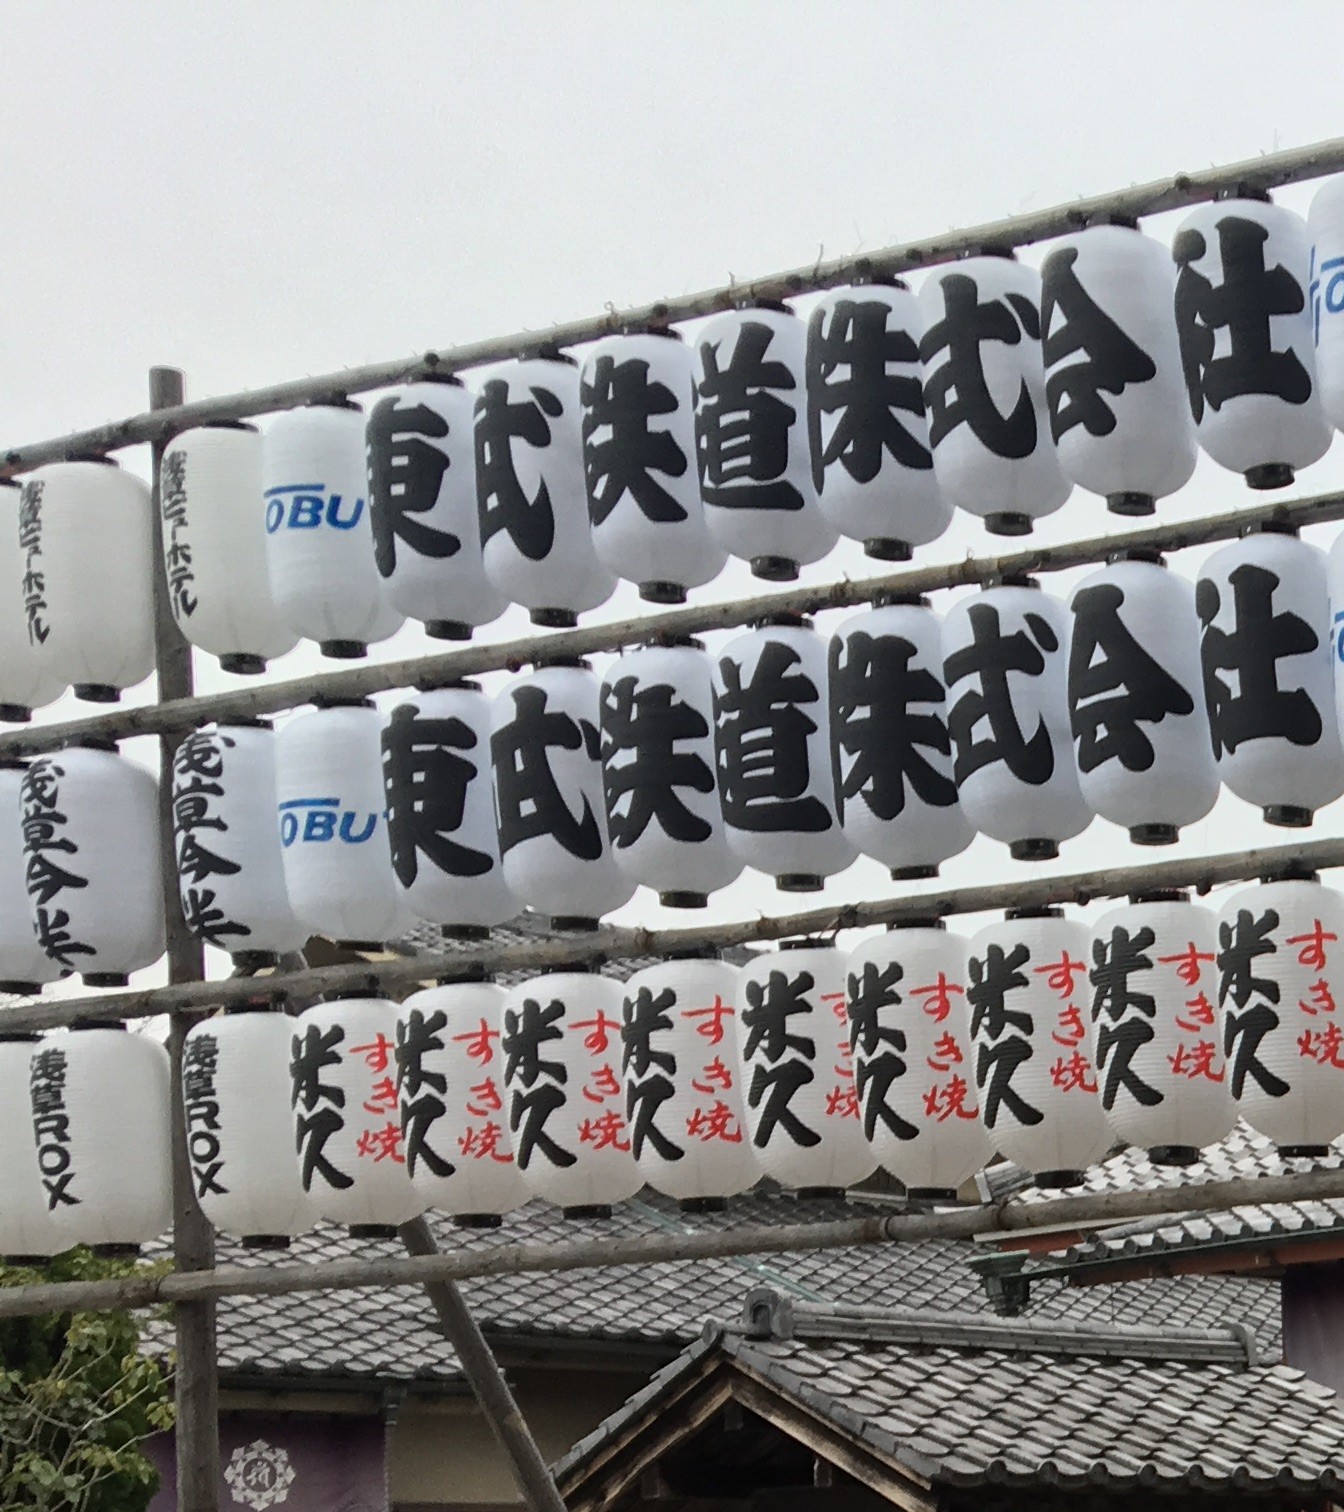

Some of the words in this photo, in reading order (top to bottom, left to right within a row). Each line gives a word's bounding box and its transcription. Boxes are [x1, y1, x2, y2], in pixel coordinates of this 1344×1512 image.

[503, 1000, 577, 1170] 米久
[570, 1012, 630, 1151] すき焼
[620, 988, 686, 1161] 米久
[684, 996, 742, 1143] すき焼
[743, 971, 821, 1148] 米久
[847, 962, 920, 1142] 米久
[911, 973, 978, 1121] すき焼
[968, 944, 1044, 1129] 米久
[1036, 953, 1097, 1093] すき焼
[1090, 927, 1163, 1111] 米久
[1160, 941, 1224, 1082] すき焼
[1217, 909, 1289, 1100] 米久
[290, 1025, 355, 1192] 米久
[353, 1035, 404, 1163] すき焼
[397, 1011, 455, 1178] 米久
[455, 1017, 513, 1163] すき焼
